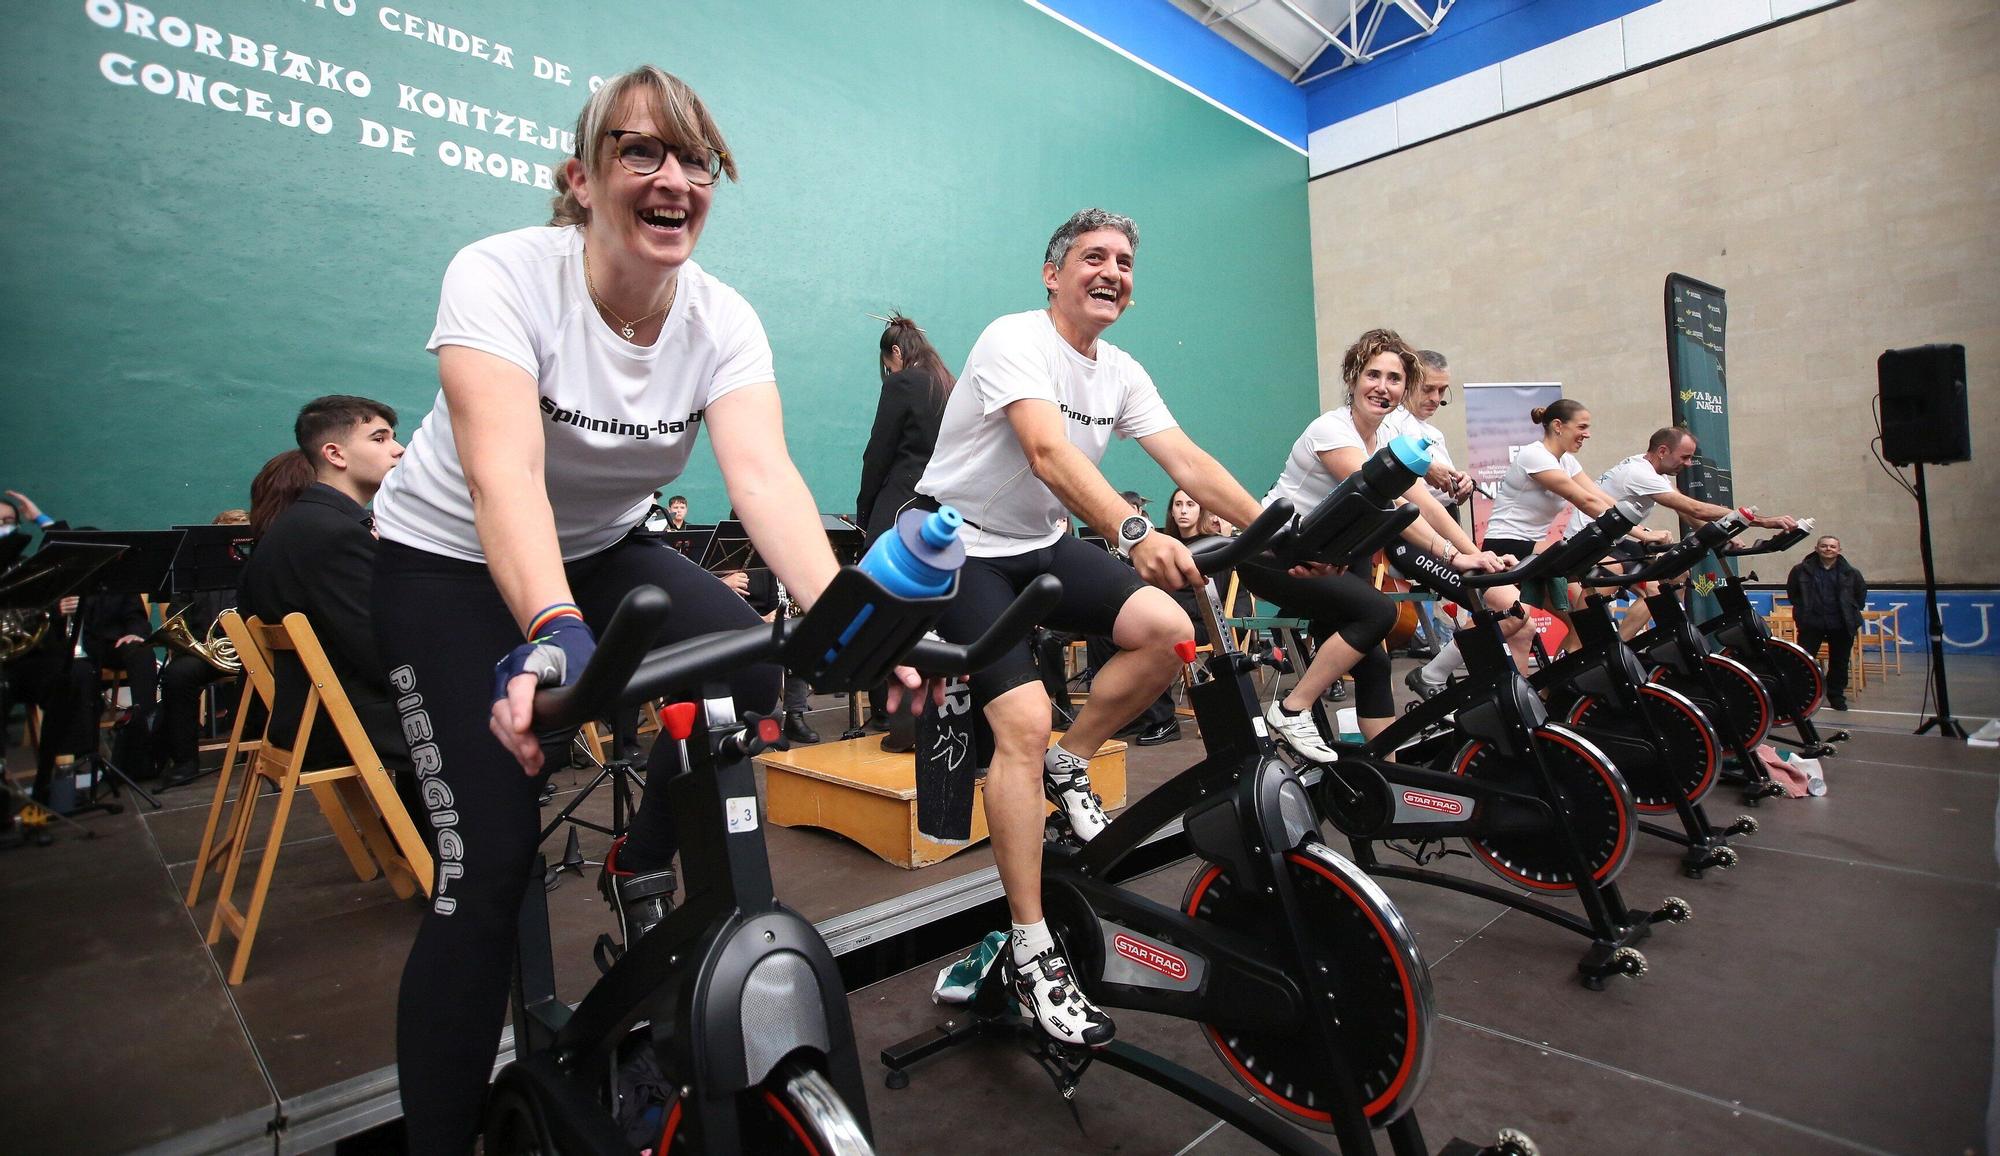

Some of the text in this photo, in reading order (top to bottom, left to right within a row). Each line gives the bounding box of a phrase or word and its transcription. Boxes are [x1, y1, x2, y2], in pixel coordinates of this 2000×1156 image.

[378, 7, 572, 87] CENDEA DE
[100, 52, 555, 191] CONCEJO DE ORORB
[397, 83, 576, 155] KONTZEJU
[540, 395, 706, 440] Spinning-bad
[1415, 555, 1461, 588] ORKUC
[390, 664, 464, 916] PIERGIGLI
[1406, 795, 1458, 811] STAR TRAC
[744, 808, 752, 822] 3
[1118, 941, 1181, 973] STAR TRAC
